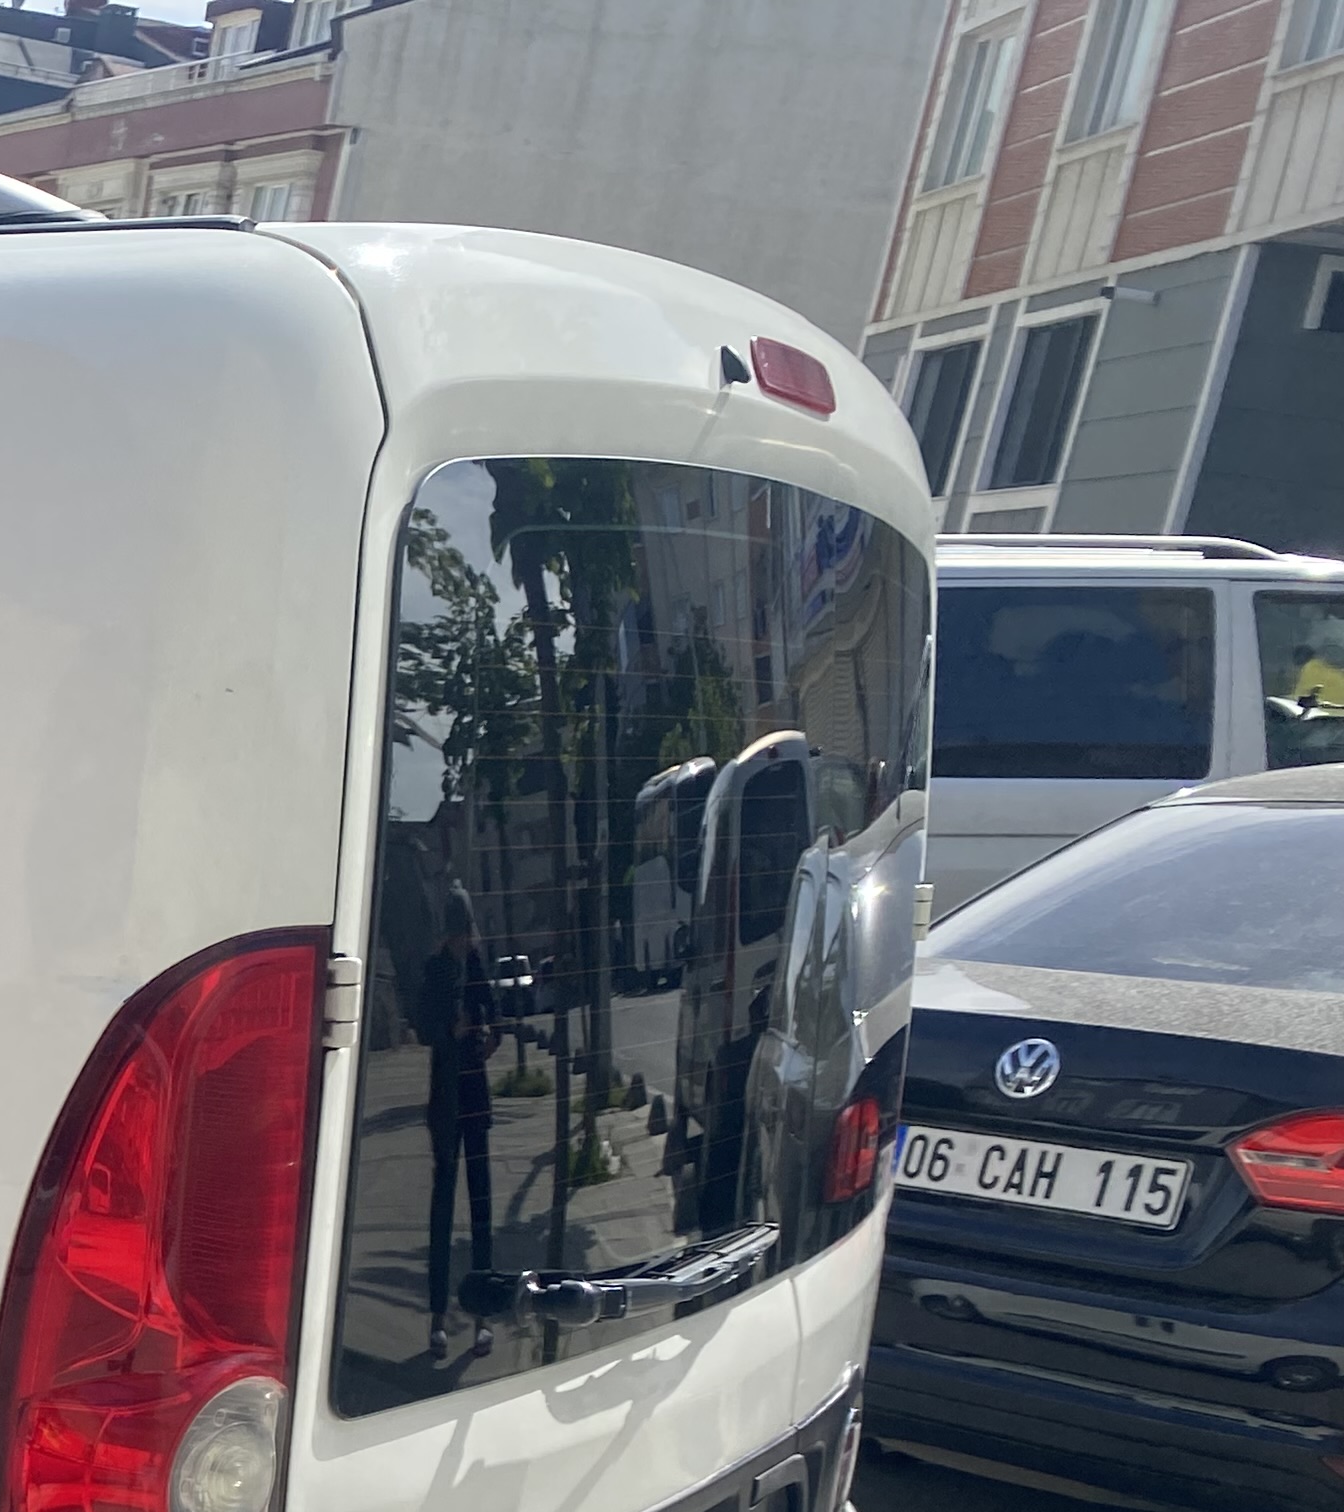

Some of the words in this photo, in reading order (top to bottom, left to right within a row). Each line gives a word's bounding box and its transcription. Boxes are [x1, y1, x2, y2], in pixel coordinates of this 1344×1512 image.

[903, 1135, 954, 1182] 06
[978, 1145, 1063, 1199] CAH
[1094, 1160, 1178, 1216] 115
